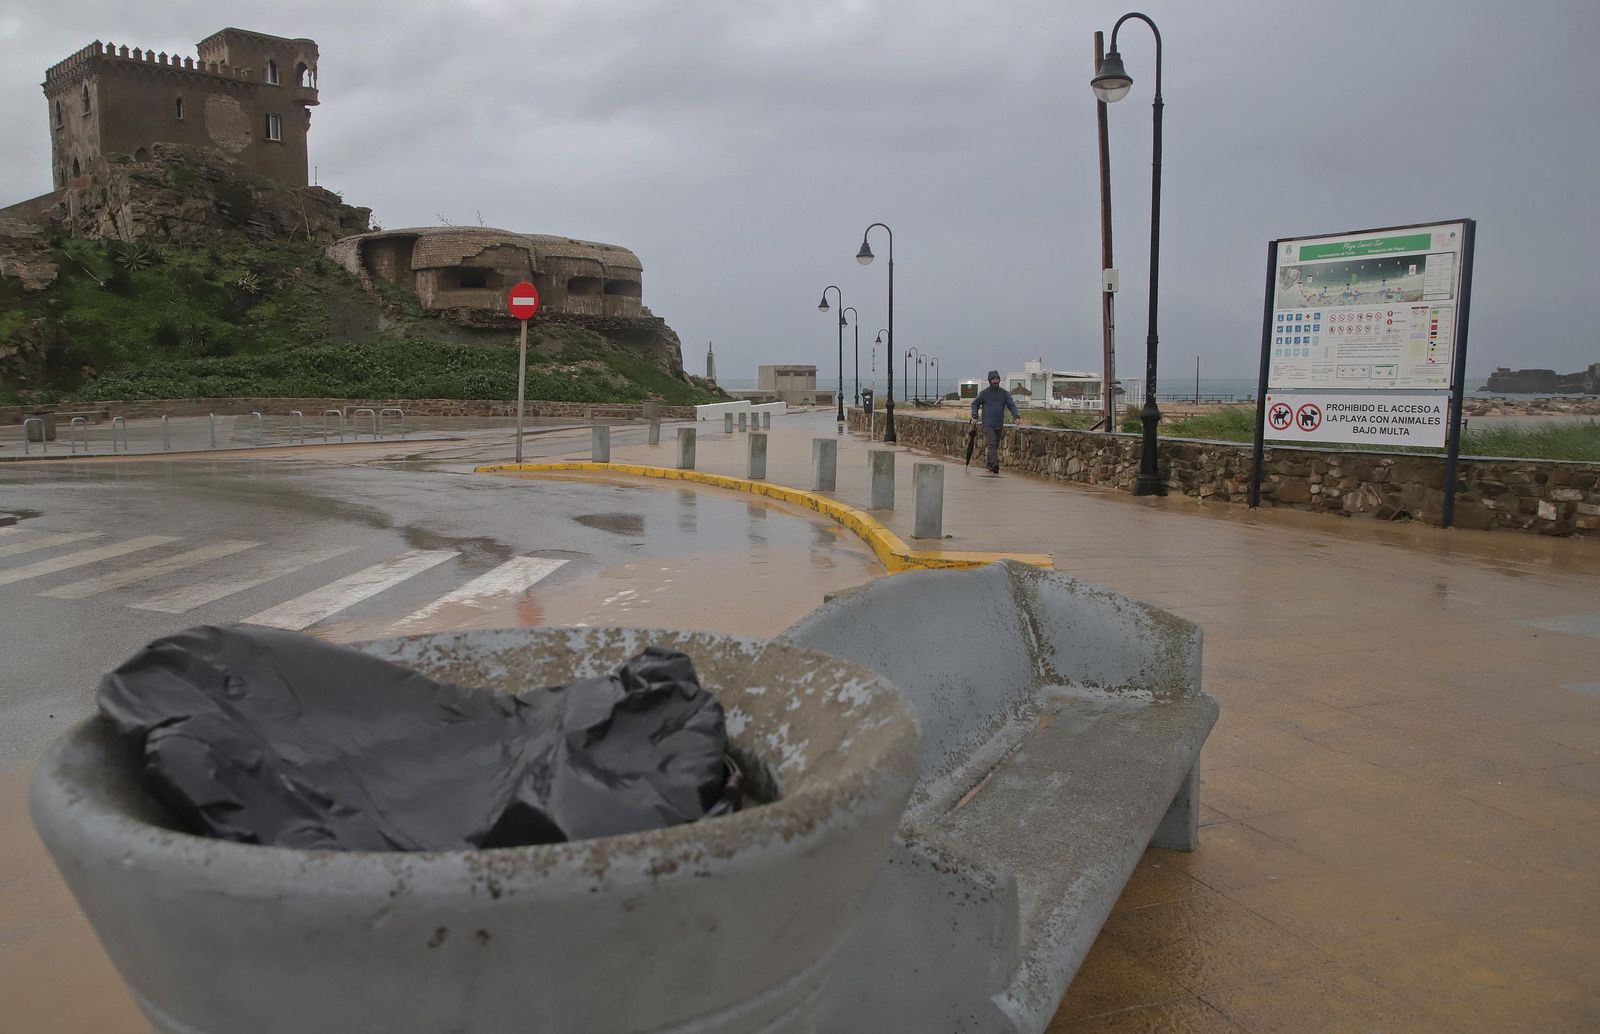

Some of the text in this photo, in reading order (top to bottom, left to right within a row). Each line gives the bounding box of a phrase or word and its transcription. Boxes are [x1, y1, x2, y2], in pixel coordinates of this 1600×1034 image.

[1326, 404, 1375, 412] PROHIBIDO
[1377, 404, 1388, 412] EL
[1390, 404, 1431, 414] ACCESO
[1340, 415, 1367, 423] PLAYA
[1370, 416, 1389, 424] CON
[1391, 416, 1441, 425] ANIMALES
[1352, 426, 1410, 436] BAJO MULTA
